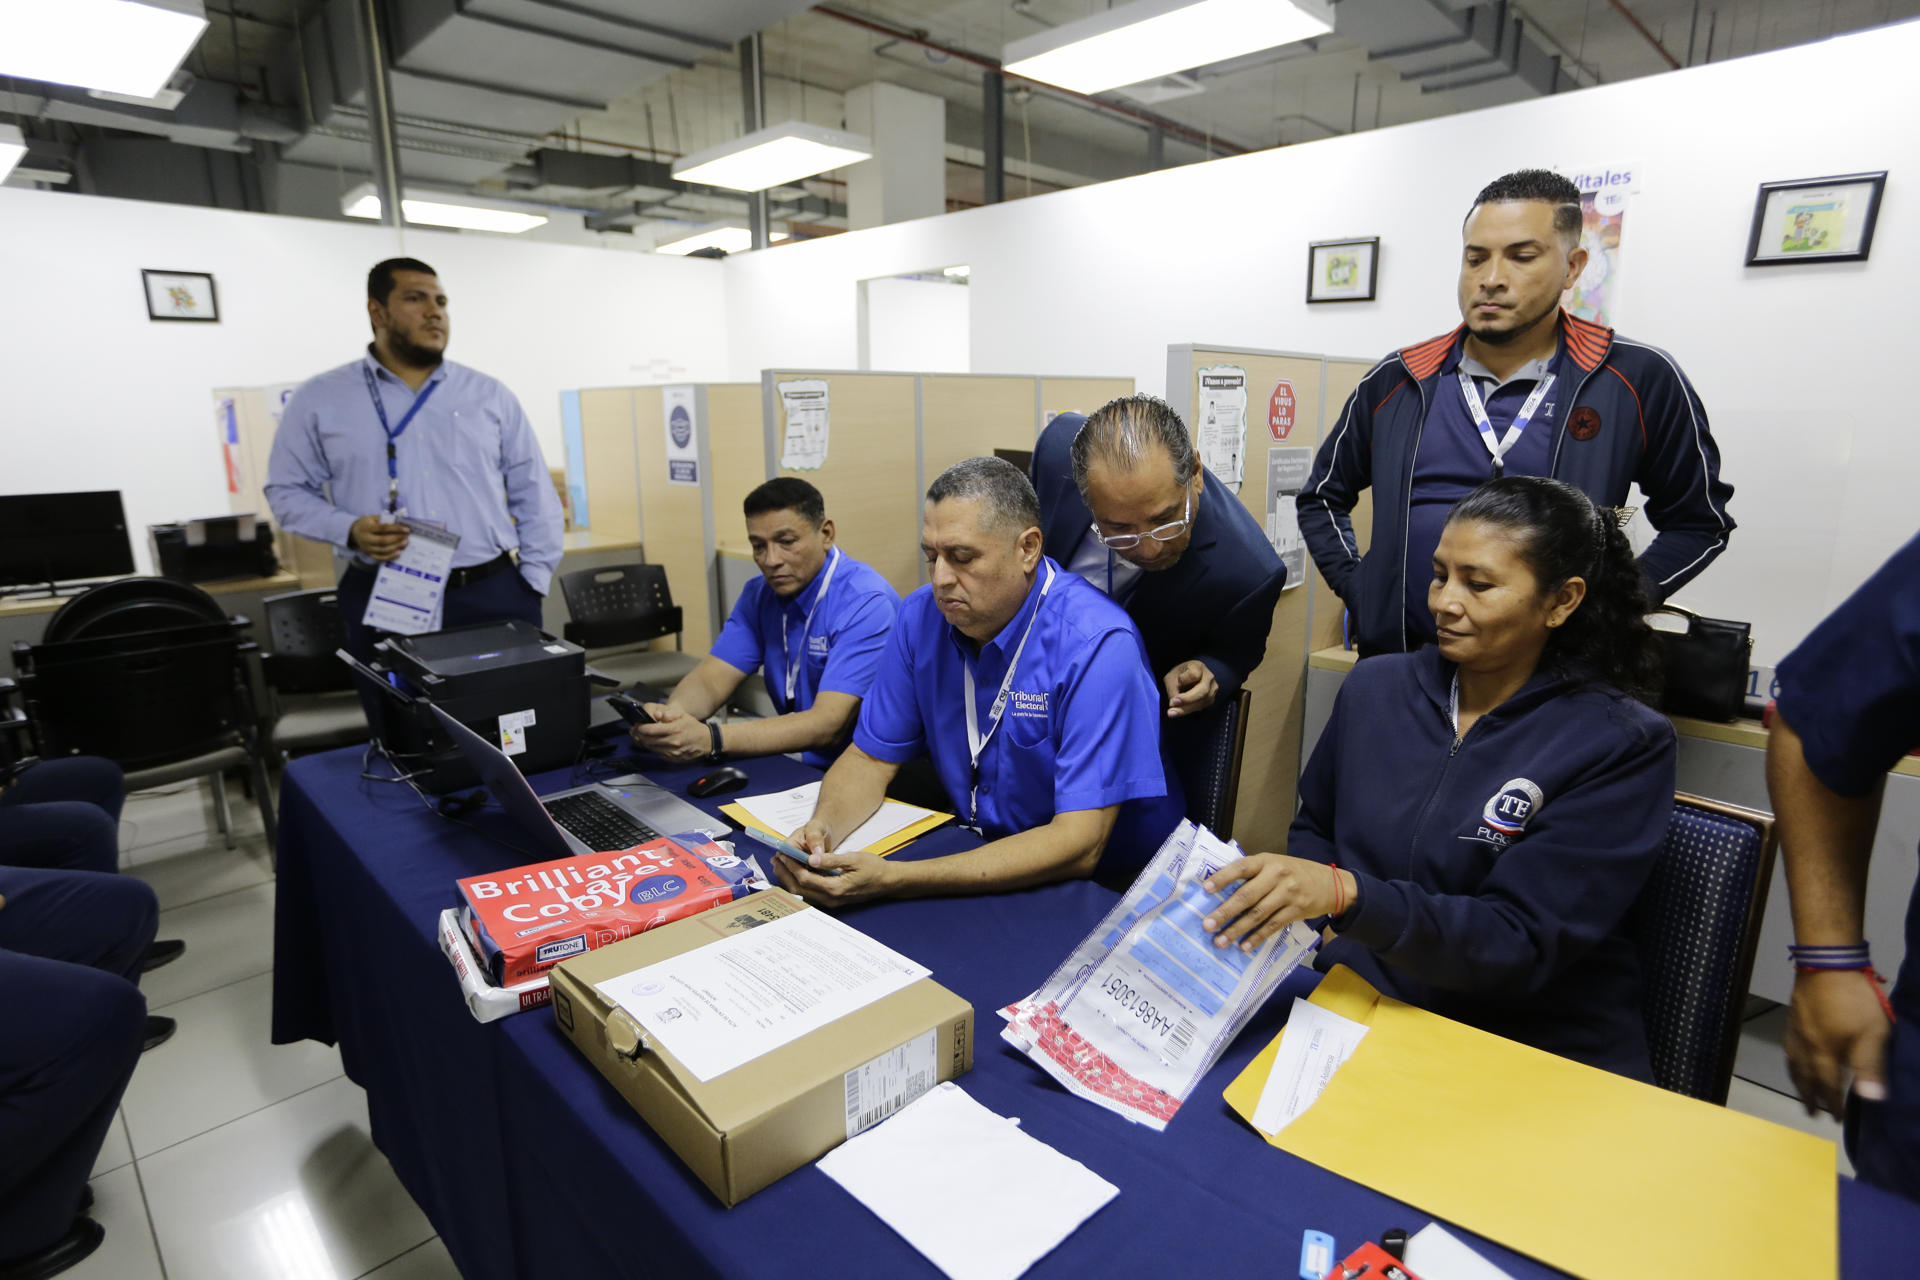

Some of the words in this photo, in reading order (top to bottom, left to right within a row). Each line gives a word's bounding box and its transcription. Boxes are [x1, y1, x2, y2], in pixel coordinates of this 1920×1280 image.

[1280, 387, 1288, 396] EL
[1274, 397, 1292, 406] VIRUS
[1278, 407, 1287, 416] LO
[1272, 416, 1291, 426] PARAS
[1009, 690, 1044, 703] Tribunal
[1015, 701, 1044, 711] Electoral
[1499, 794, 1531, 818] TE
[469, 849, 662, 900] Brilliant
[555, 857, 675, 904] Laser
[502, 880, 628, 922] Copy
[638, 880, 681, 902] BLC
[543, 940, 580, 954] TRUTONE
[1101, 973, 1175, 1037] AA8613051
